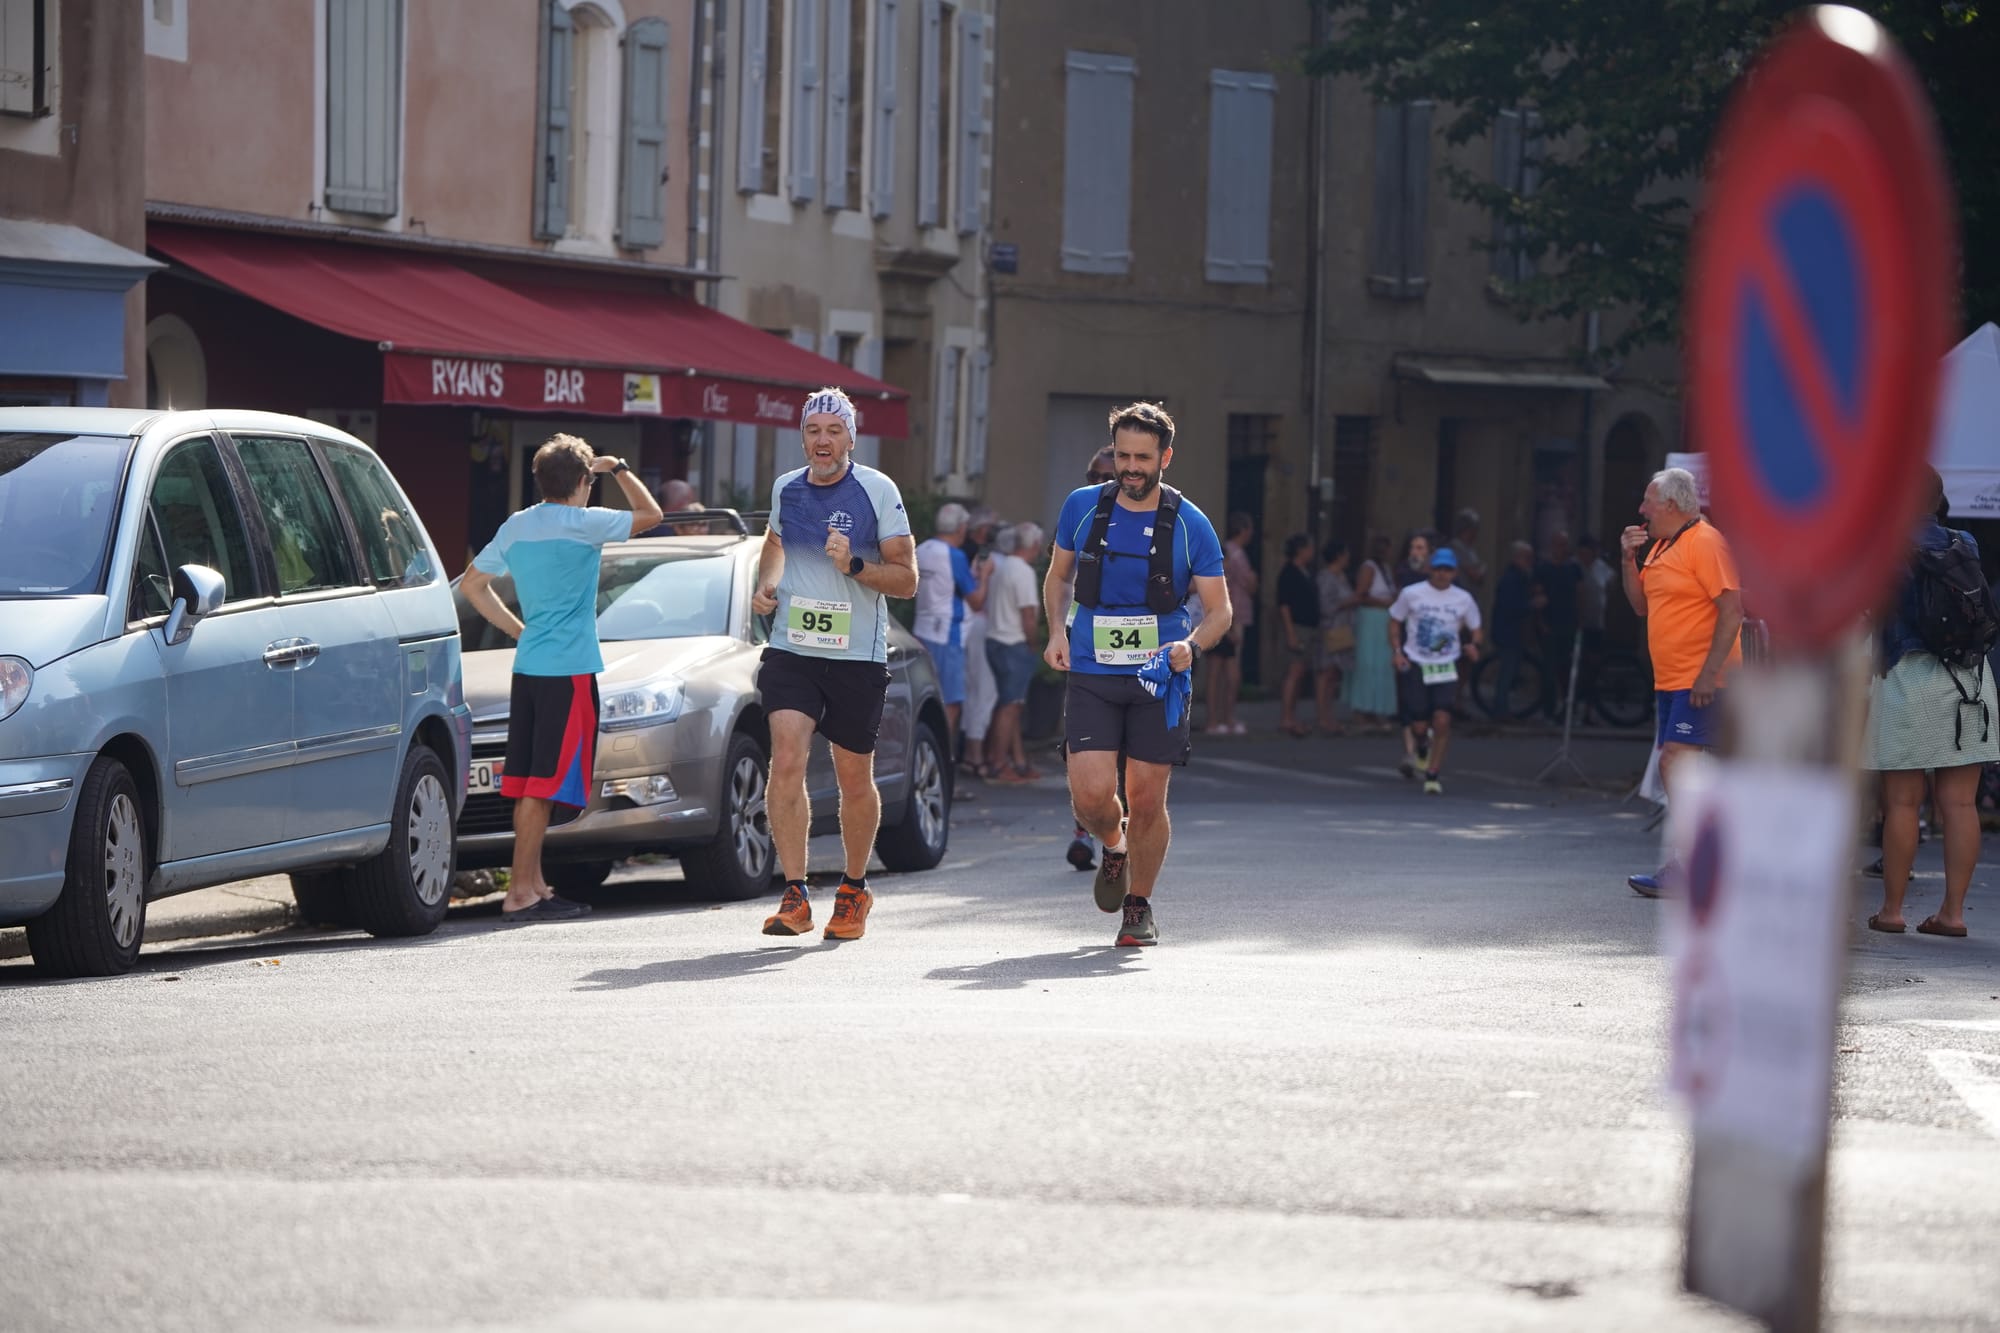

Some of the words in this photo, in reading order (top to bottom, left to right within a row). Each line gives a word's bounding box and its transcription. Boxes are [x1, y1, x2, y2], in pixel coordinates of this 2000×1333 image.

[432, 359, 504, 398] RYAN'S
[543, 368, 585, 404] BAR
[802, 611, 833, 633] 95
[1109, 629, 1142, 649] 34
